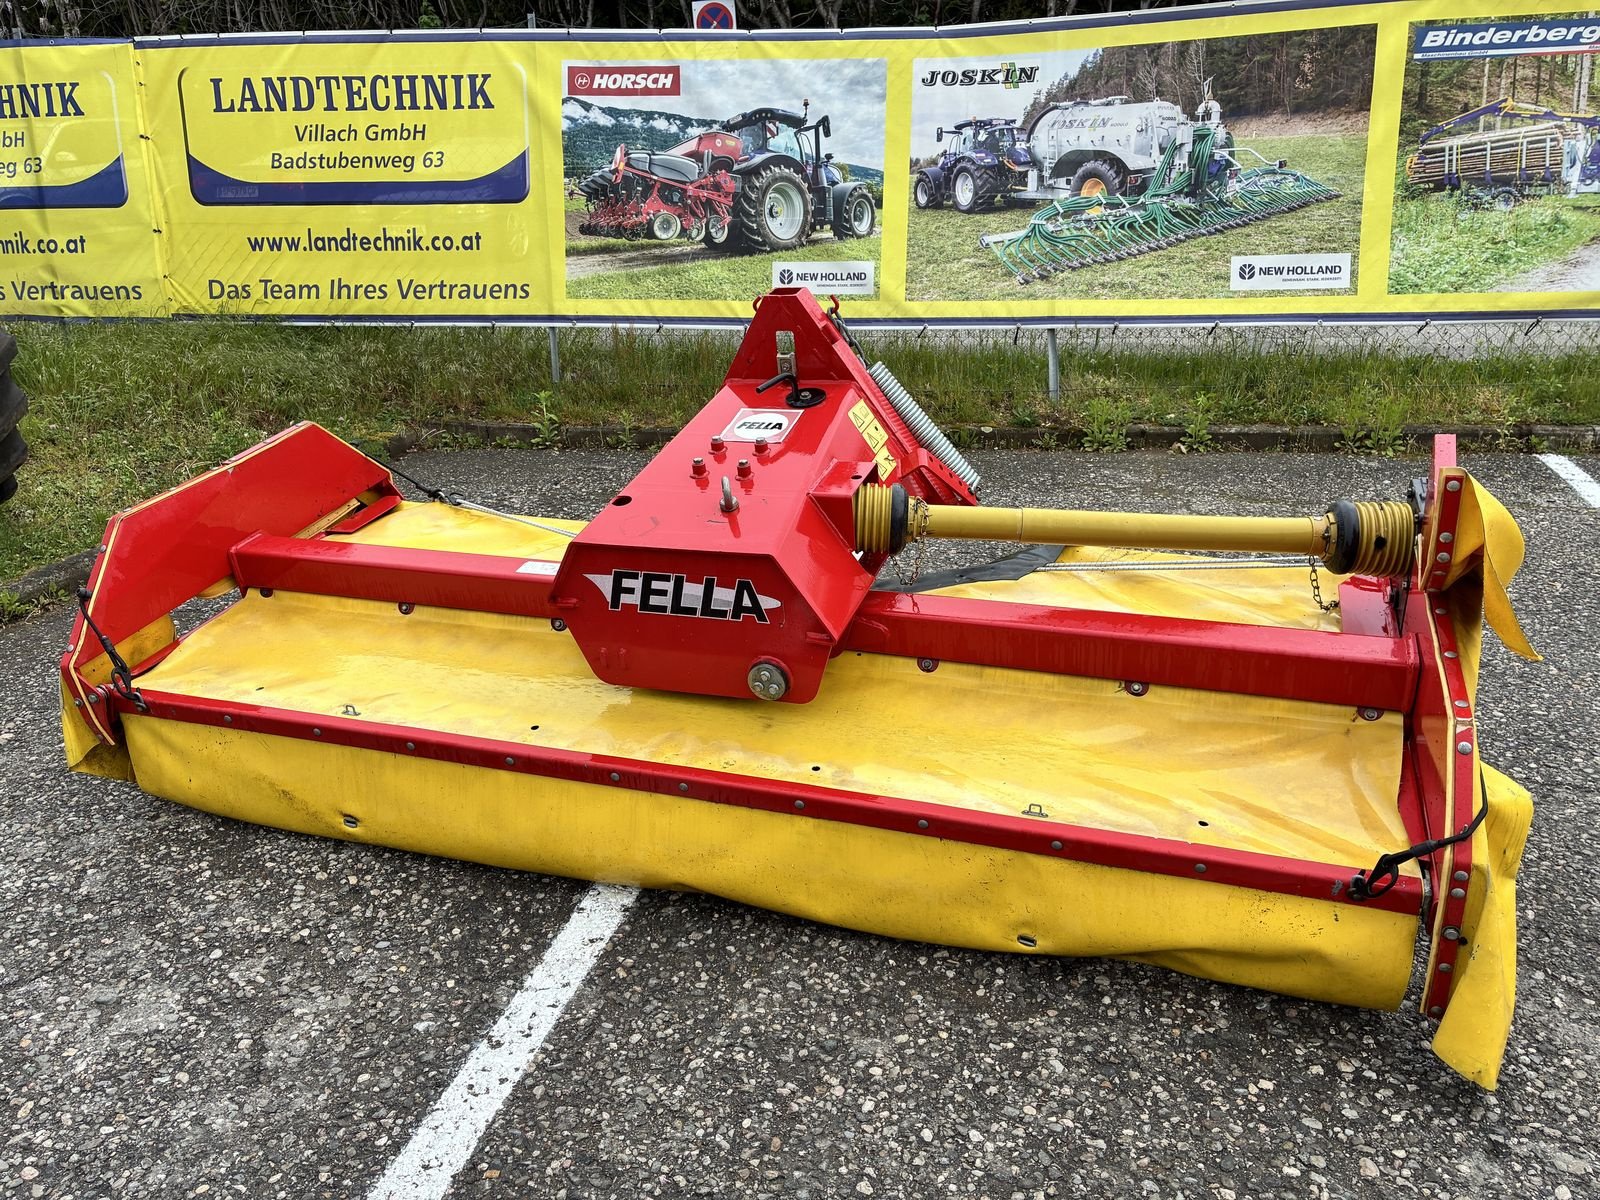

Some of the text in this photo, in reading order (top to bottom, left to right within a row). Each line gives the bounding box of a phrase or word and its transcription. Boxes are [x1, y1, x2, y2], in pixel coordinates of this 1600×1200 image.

[592, 73, 673, 89] HORSCH
[921, 66, 1039, 86] JOSKIN
[210, 73, 495, 113] LANDTECHNIK
[294, 123, 427, 142] Villach GmbH
[24, 157, 42, 173] 63
[270, 151, 445, 172] Badstubenweg 63
[247, 227, 482, 252] www.landtechnik.co.at
[796, 272, 867, 281] NEW HOLLAND
[1259, 265, 1342, 276] NEW HOLLAND
[11, 281, 142, 300] Vertrauens
[208, 278, 530, 300] Das Team Ihres Vertrauens
[736, 421, 783, 430] FELLA
[609, 569, 770, 624] FELLA
